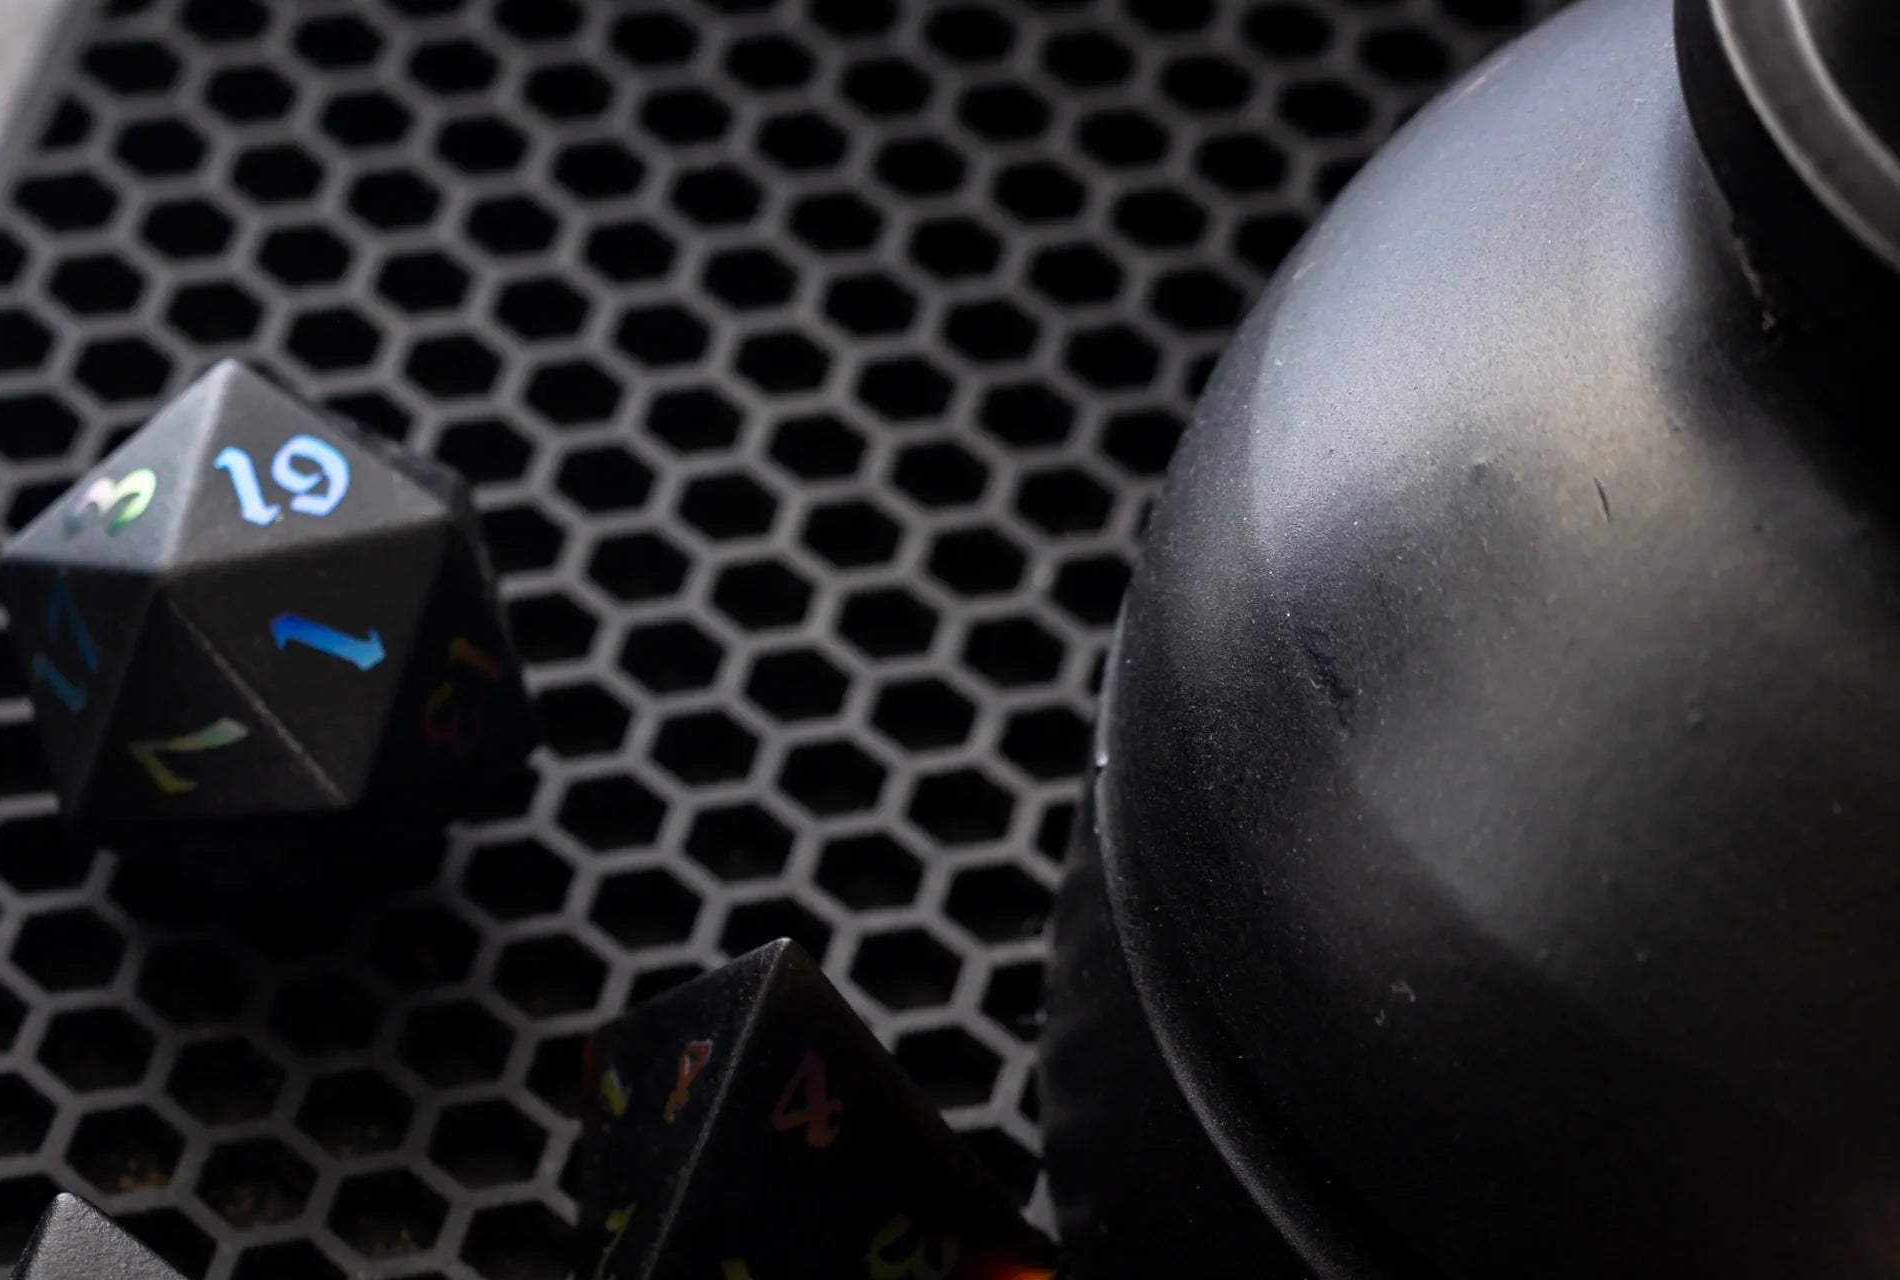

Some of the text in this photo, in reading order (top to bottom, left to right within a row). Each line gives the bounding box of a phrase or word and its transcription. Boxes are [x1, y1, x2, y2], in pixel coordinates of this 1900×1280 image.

[213, 433, 350, 527] 19
[269, 611, 388, 673] 1
[125, 716, 250, 796] 7
[771, 1048, 844, 1150] 4
